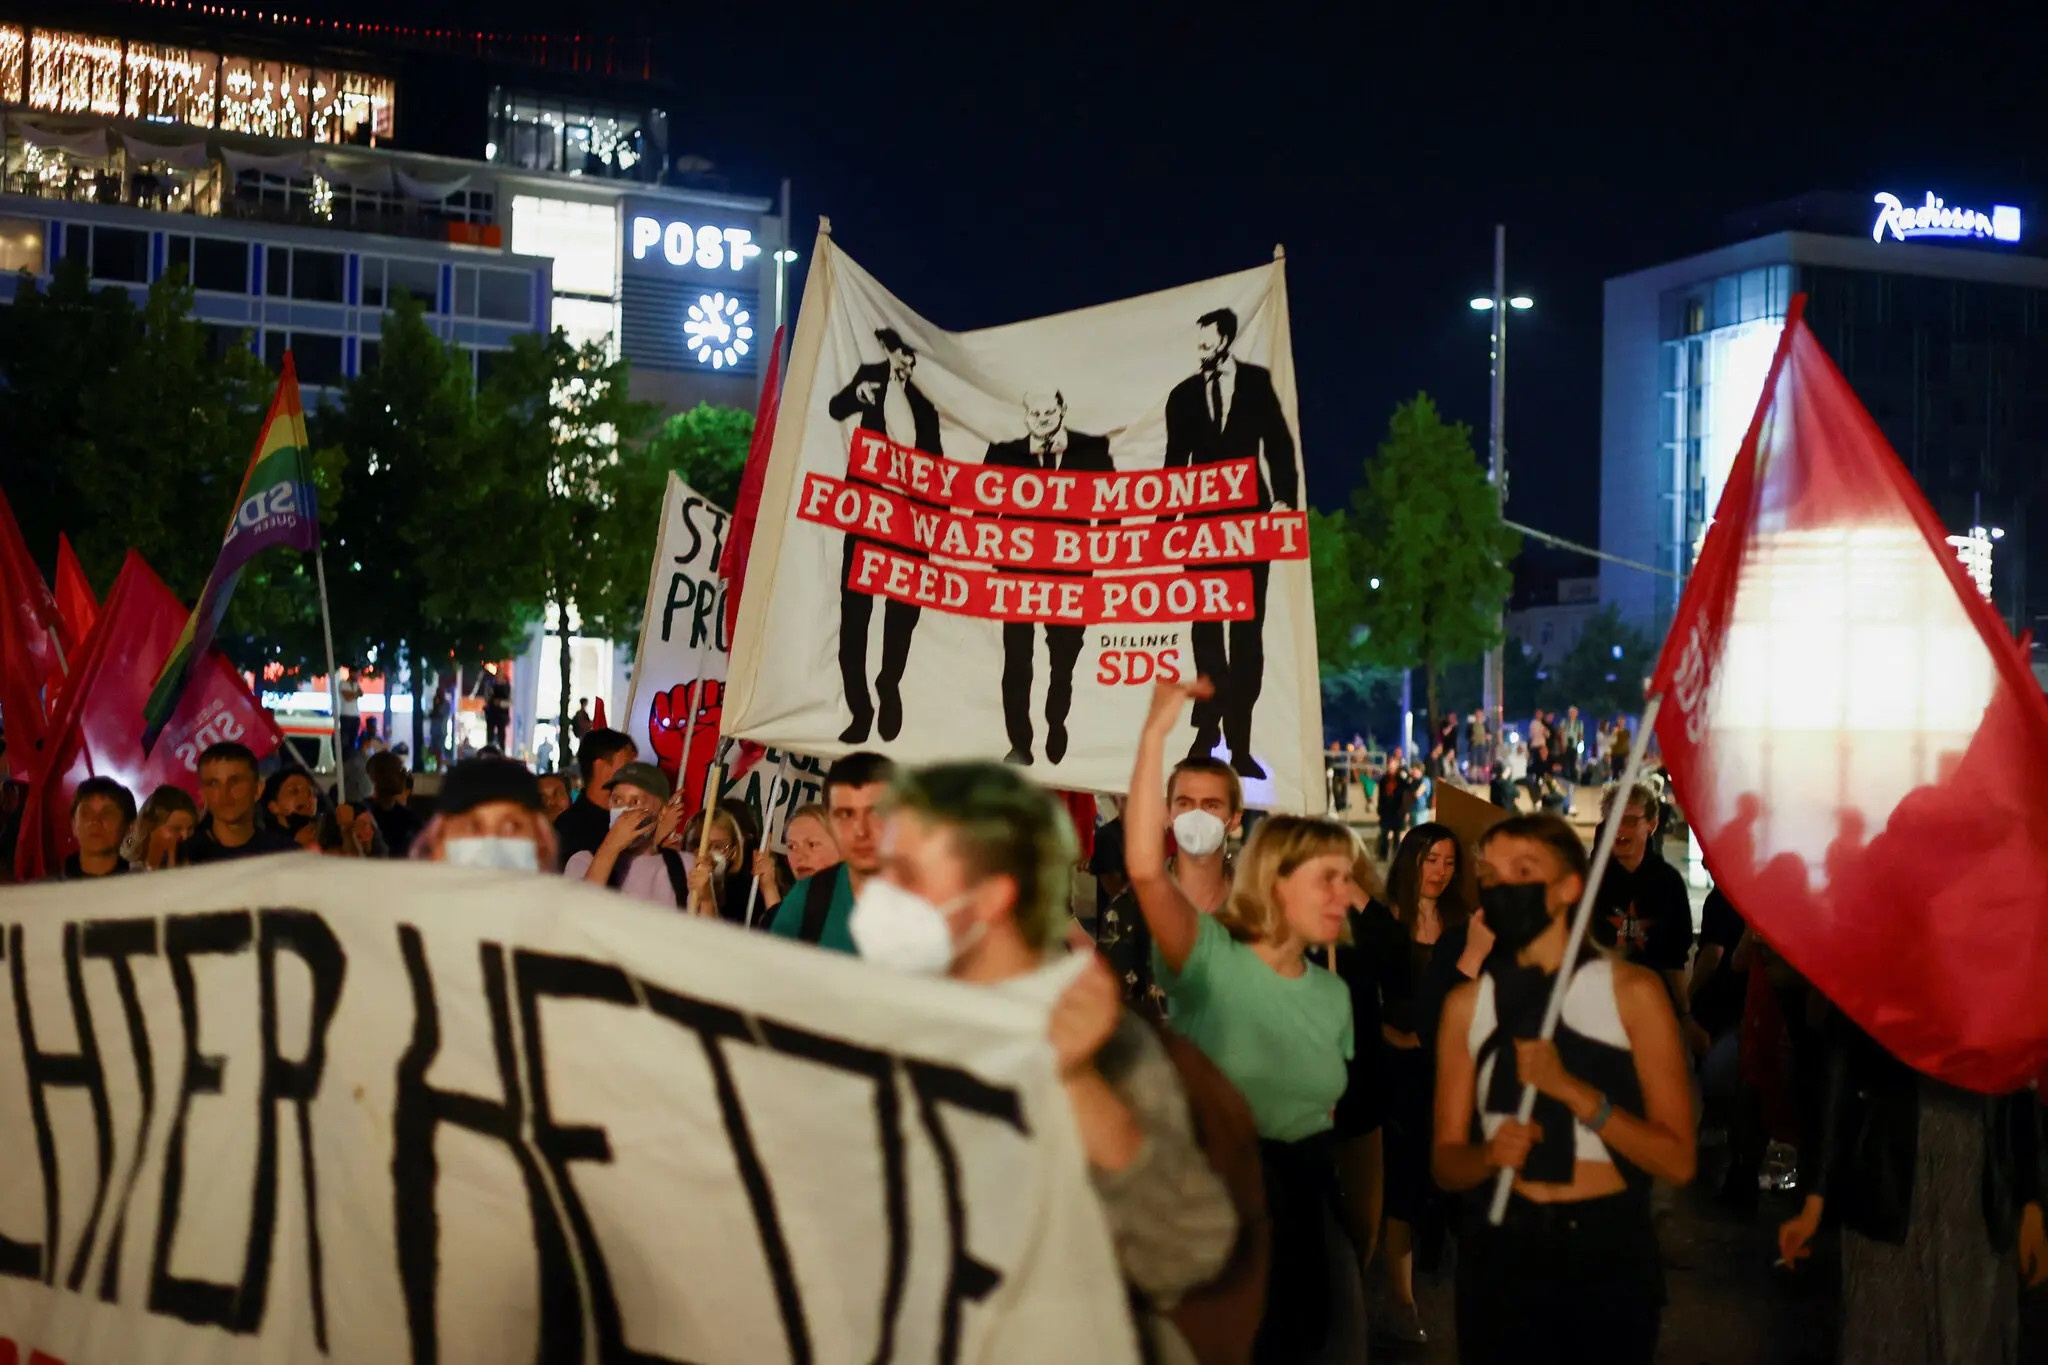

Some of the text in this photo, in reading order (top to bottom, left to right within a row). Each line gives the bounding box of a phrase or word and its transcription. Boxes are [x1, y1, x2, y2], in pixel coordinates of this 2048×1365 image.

[632, 216, 752, 271] POST
[860, 436, 1249, 512] THEY GOT MONEY
[804, 479, 1303, 565] FOR WARS BUT CAN'T
[856, 549, 1247, 619] FEED THE POOR.
[1096, 648, 1181, 686] SDS
